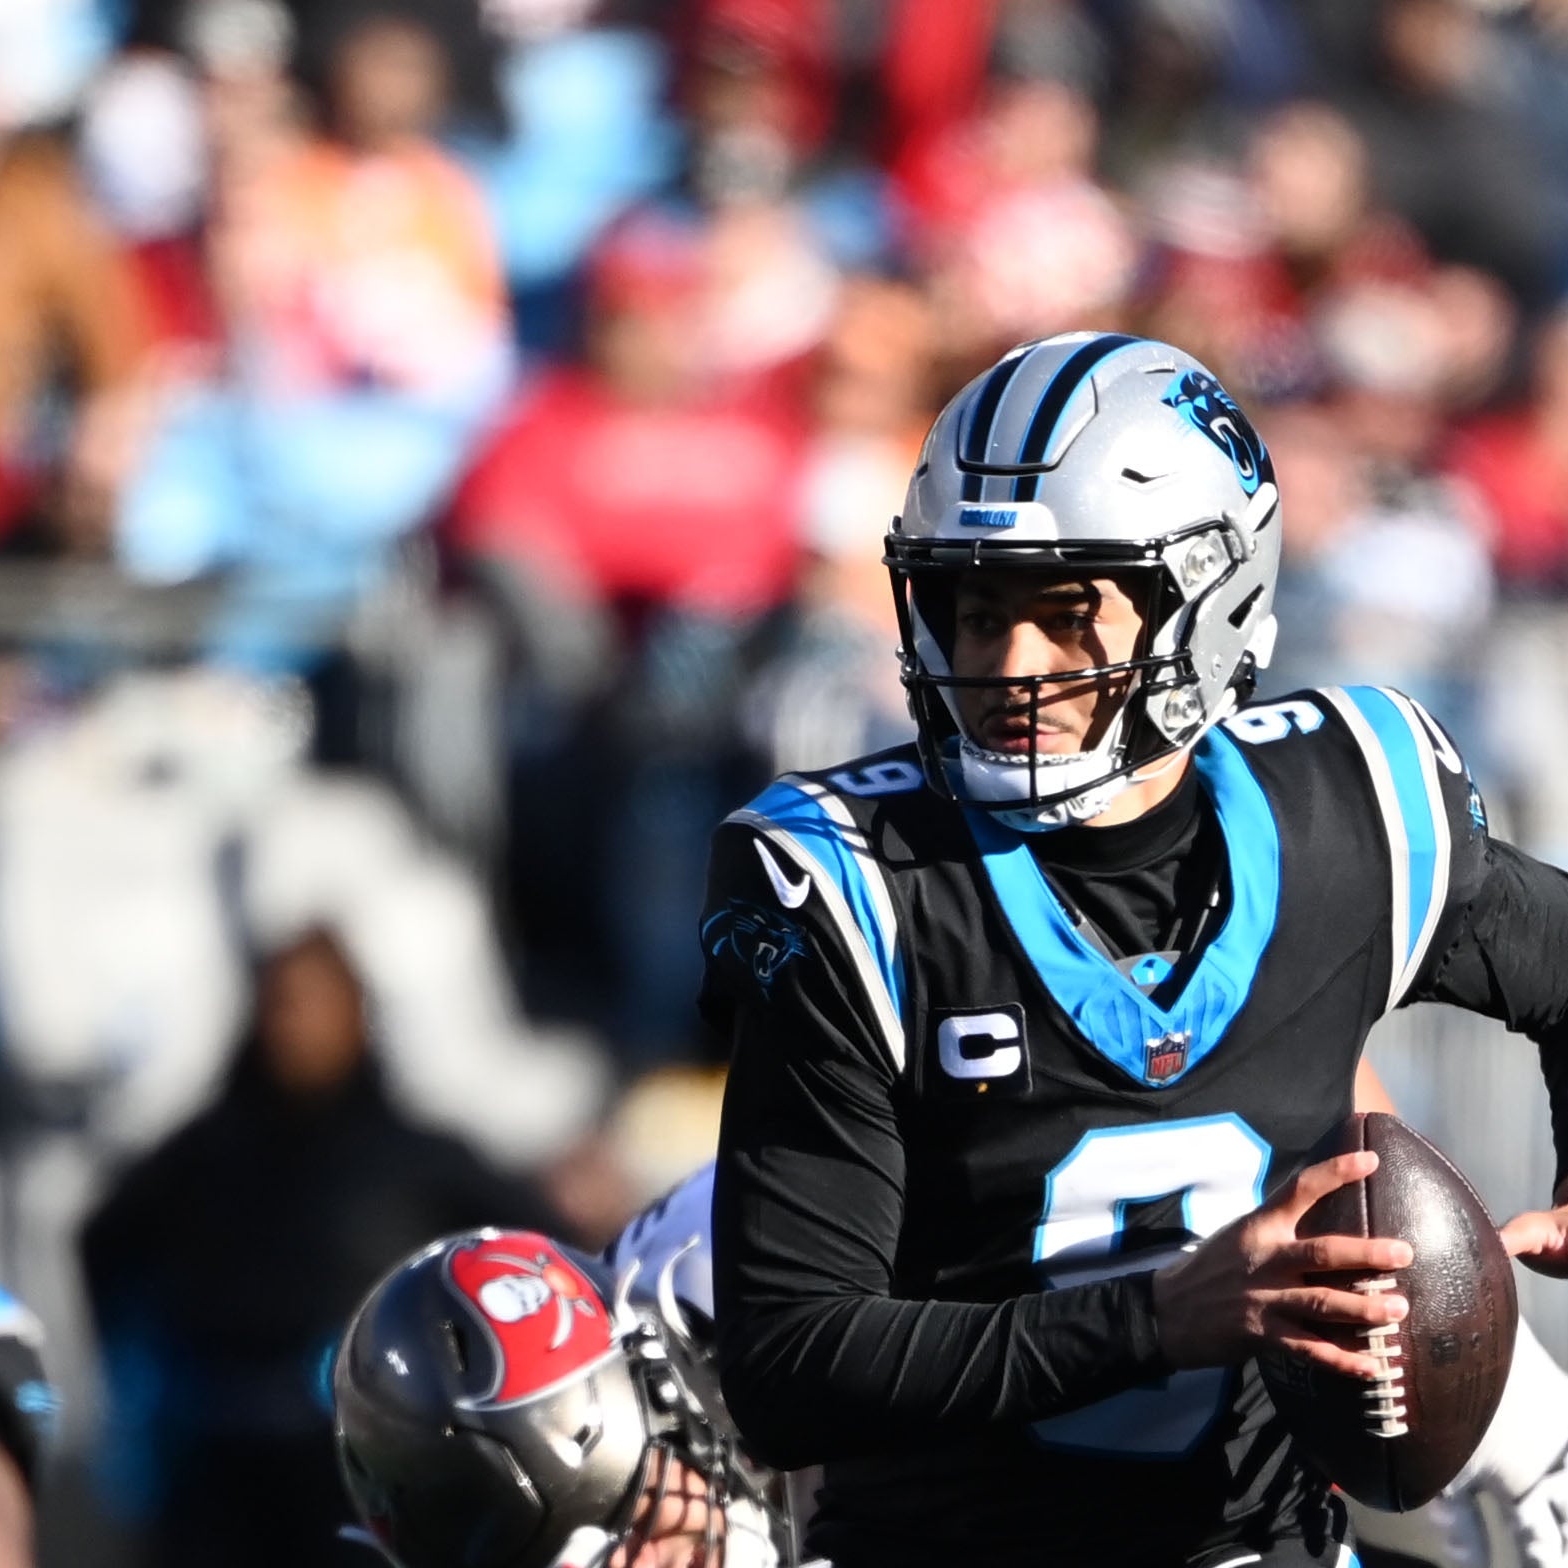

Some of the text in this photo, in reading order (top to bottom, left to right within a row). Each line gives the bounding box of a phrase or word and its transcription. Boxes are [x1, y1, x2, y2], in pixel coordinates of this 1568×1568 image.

[1227, 701, 1325, 745] 9
[831, 758, 924, 798] 9
[937, 1012, 1022, 1079] C
[1151, 1053, 1183, 1077] NFL
